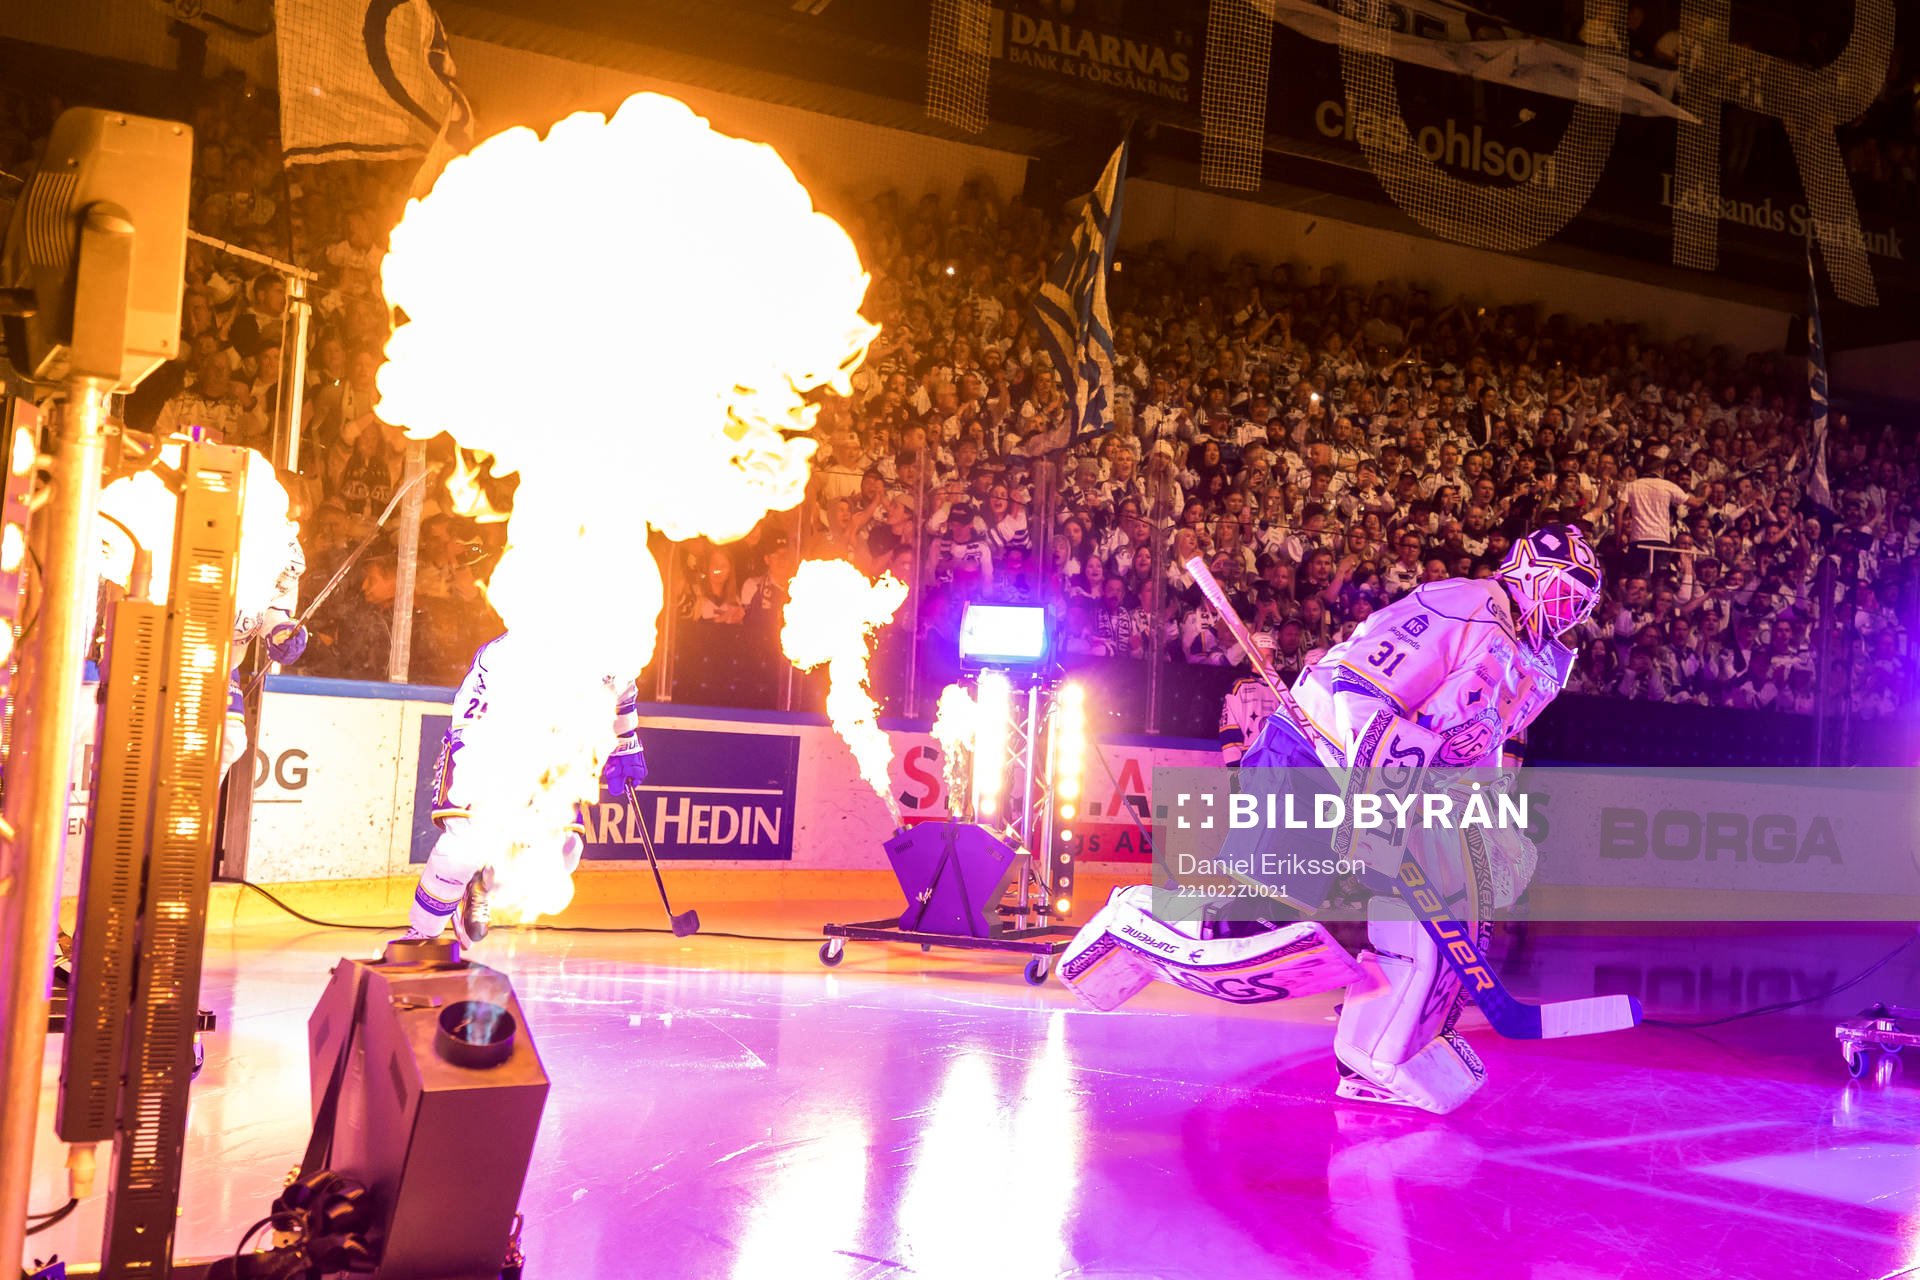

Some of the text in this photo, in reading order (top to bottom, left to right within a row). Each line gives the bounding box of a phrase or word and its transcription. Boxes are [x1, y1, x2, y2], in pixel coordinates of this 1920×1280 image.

[1010, 12, 1190, 82] DALARNAS
[1009, 50, 1189, 102] BANK & FÖRSÄKRING
[1315, 98, 1557, 189] clas ohlson
[1405, 619, 1424, 634] NS
[1367, 640, 1406, 678] 31
[654, 796, 783, 845] HEDIN
[1601, 806, 1844, 865] BORGA
[1121, 924, 1180, 955] SUPREME
[1399, 860, 1495, 993] BAUER
